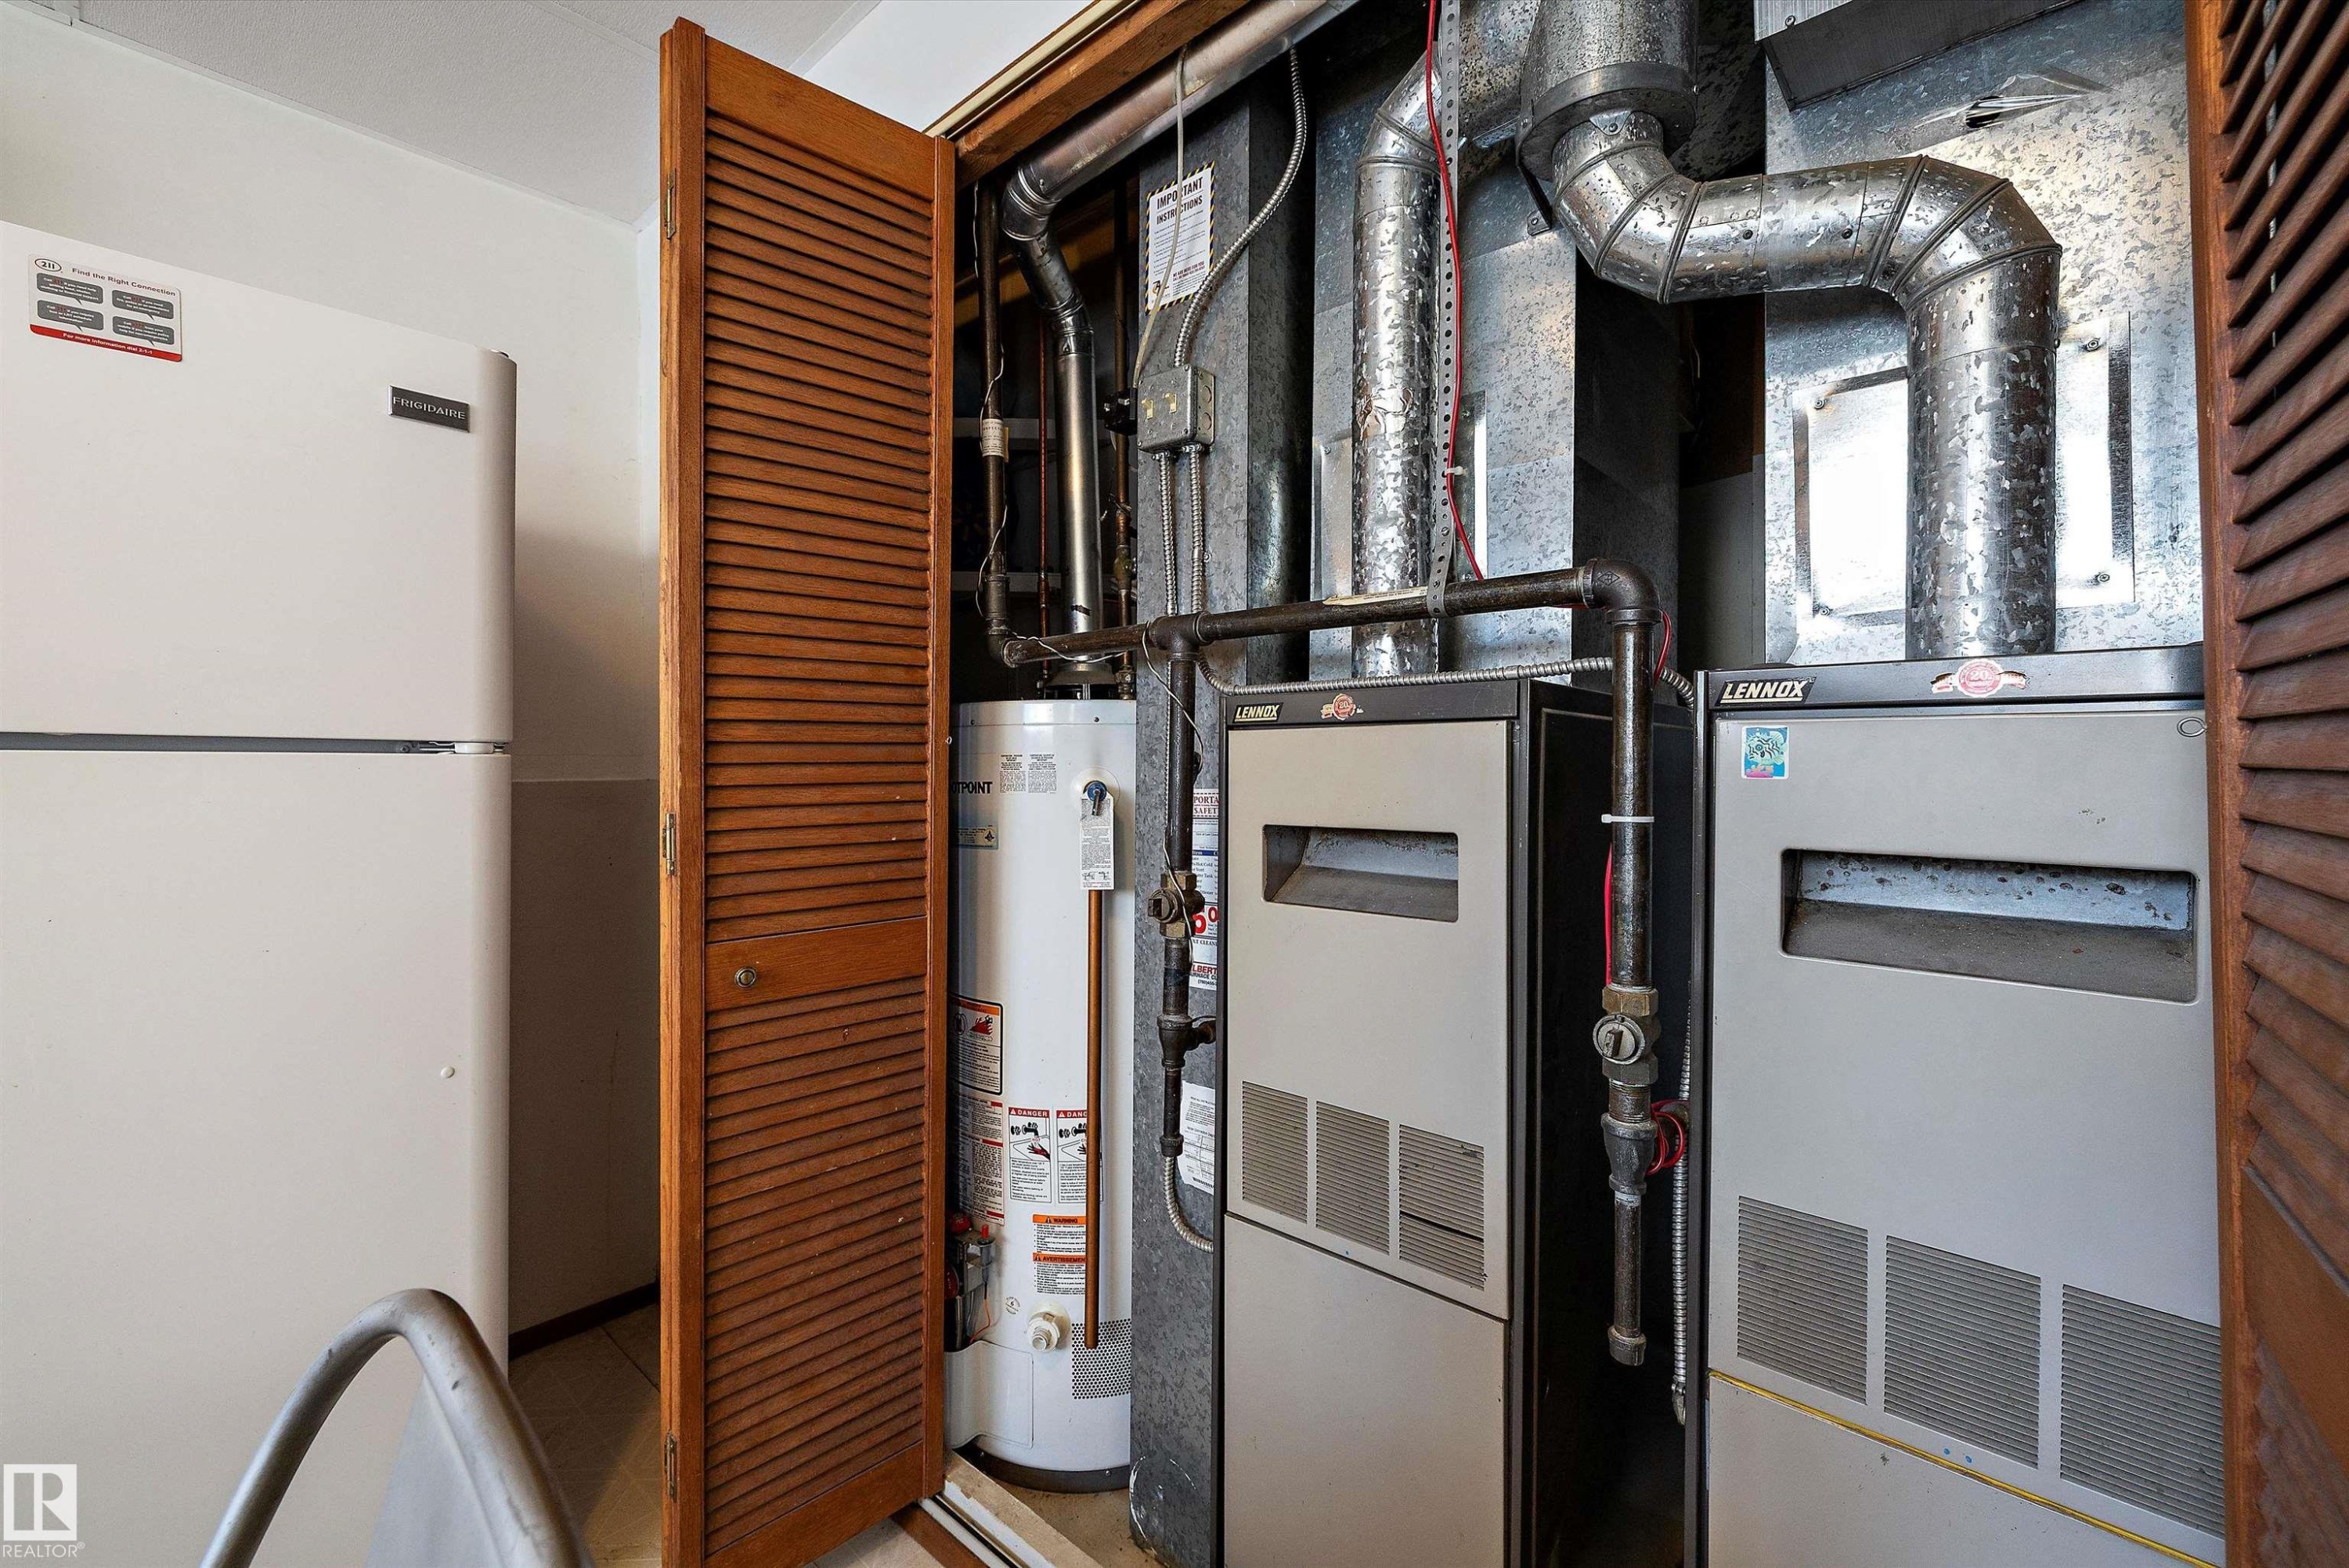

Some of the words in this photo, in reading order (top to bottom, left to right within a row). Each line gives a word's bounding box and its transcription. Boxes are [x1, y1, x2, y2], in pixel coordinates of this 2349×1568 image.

[1157, 176, 1203, 210] IMPOTANT
[72, 268, 91, 276] Find
[107, 276, 129, 287] Right
[131, 282, 176, 297] Connection
[92, 338, 126, 349] information
[393, 396, 466, 420] FRIGIDAIRE
[1722, 680, 1809, 699] LENNOX
[1236, 704, 1280, 719] LENNOX
[1018, 1108, 1048, 1117] DANGER
